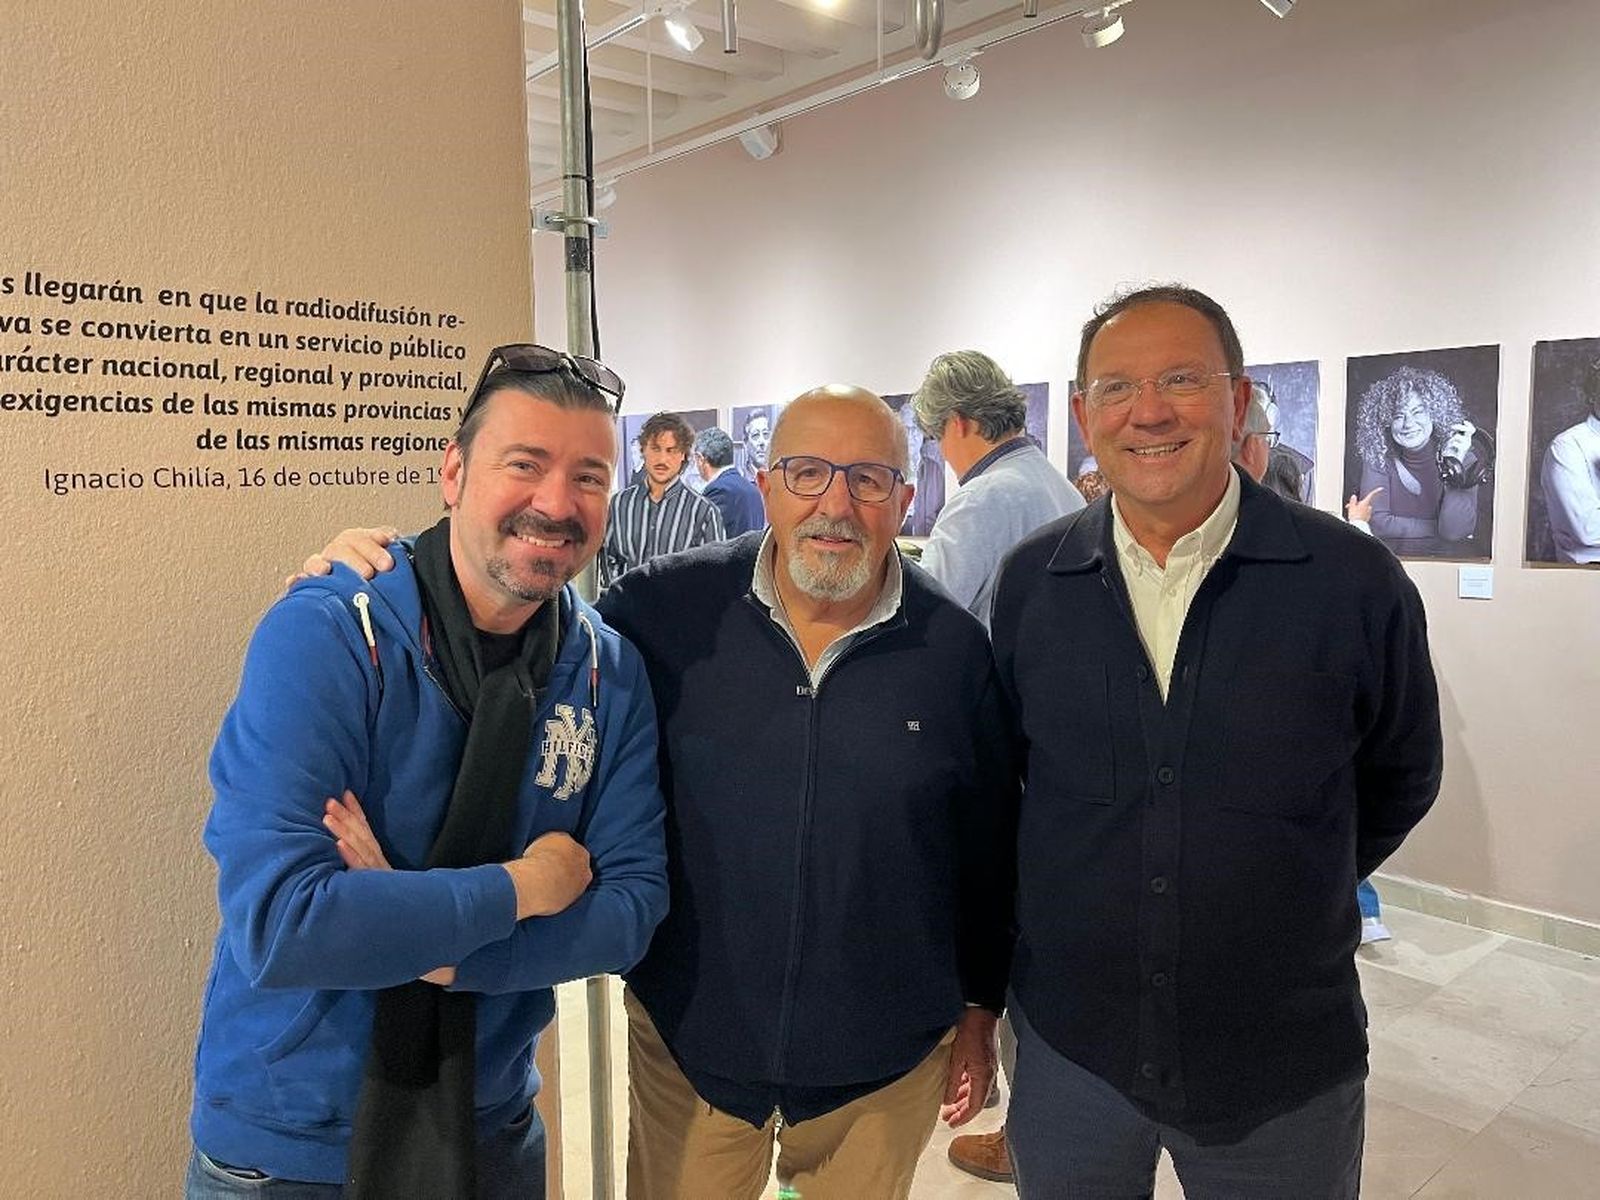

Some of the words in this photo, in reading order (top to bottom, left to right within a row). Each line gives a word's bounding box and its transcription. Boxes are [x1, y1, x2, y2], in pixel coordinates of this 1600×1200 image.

[1, 277, 14, 295] s
[25, 272, 143, 305] llegarán
[158, 290, 191, 307] en
[200, 293, 247, 315] que
[256, 292, 279, 314] la
[286, 298, 431, 326] radiodifusión
[438, 314, 465, 328] re-
[41, 318, 71, 336] se
[81, 320, 212, 344] convierta
[220, 330, 251, 347] en
[259, 333, 289, 349] un
[296, 333, 383, 355] servicio
[390, 335, 465, 361] público
[0, 345, 94, 374] rácter
[102, 356, 227, 384] nacional,
[235, 363, 334, 388] regional
[340, 371, 353, 391] y
[360, 369, 467, 393] provincial,
[0, 388, 153, 417] exigencias
[163, 392, 194, 414] de
[204, 393, 239, 415] las
[247, 397, 336, 418] mismas
[344, 400, 451, 423] provincias
[197, 428, 227, 450] de
[237, 428, 270, 450] las
[278, 431, 363, 451] mismas
[372, 432, 448, 456] regione
[46, 468, 144, 495] Ignacio
[154, 466, 230, 490] Chilía,
[238, 468, 265, 487] 16
[274, 466, 301, 486] de
[309, 467, 389, 486] octubre
[397, 466, 420, 485] de
